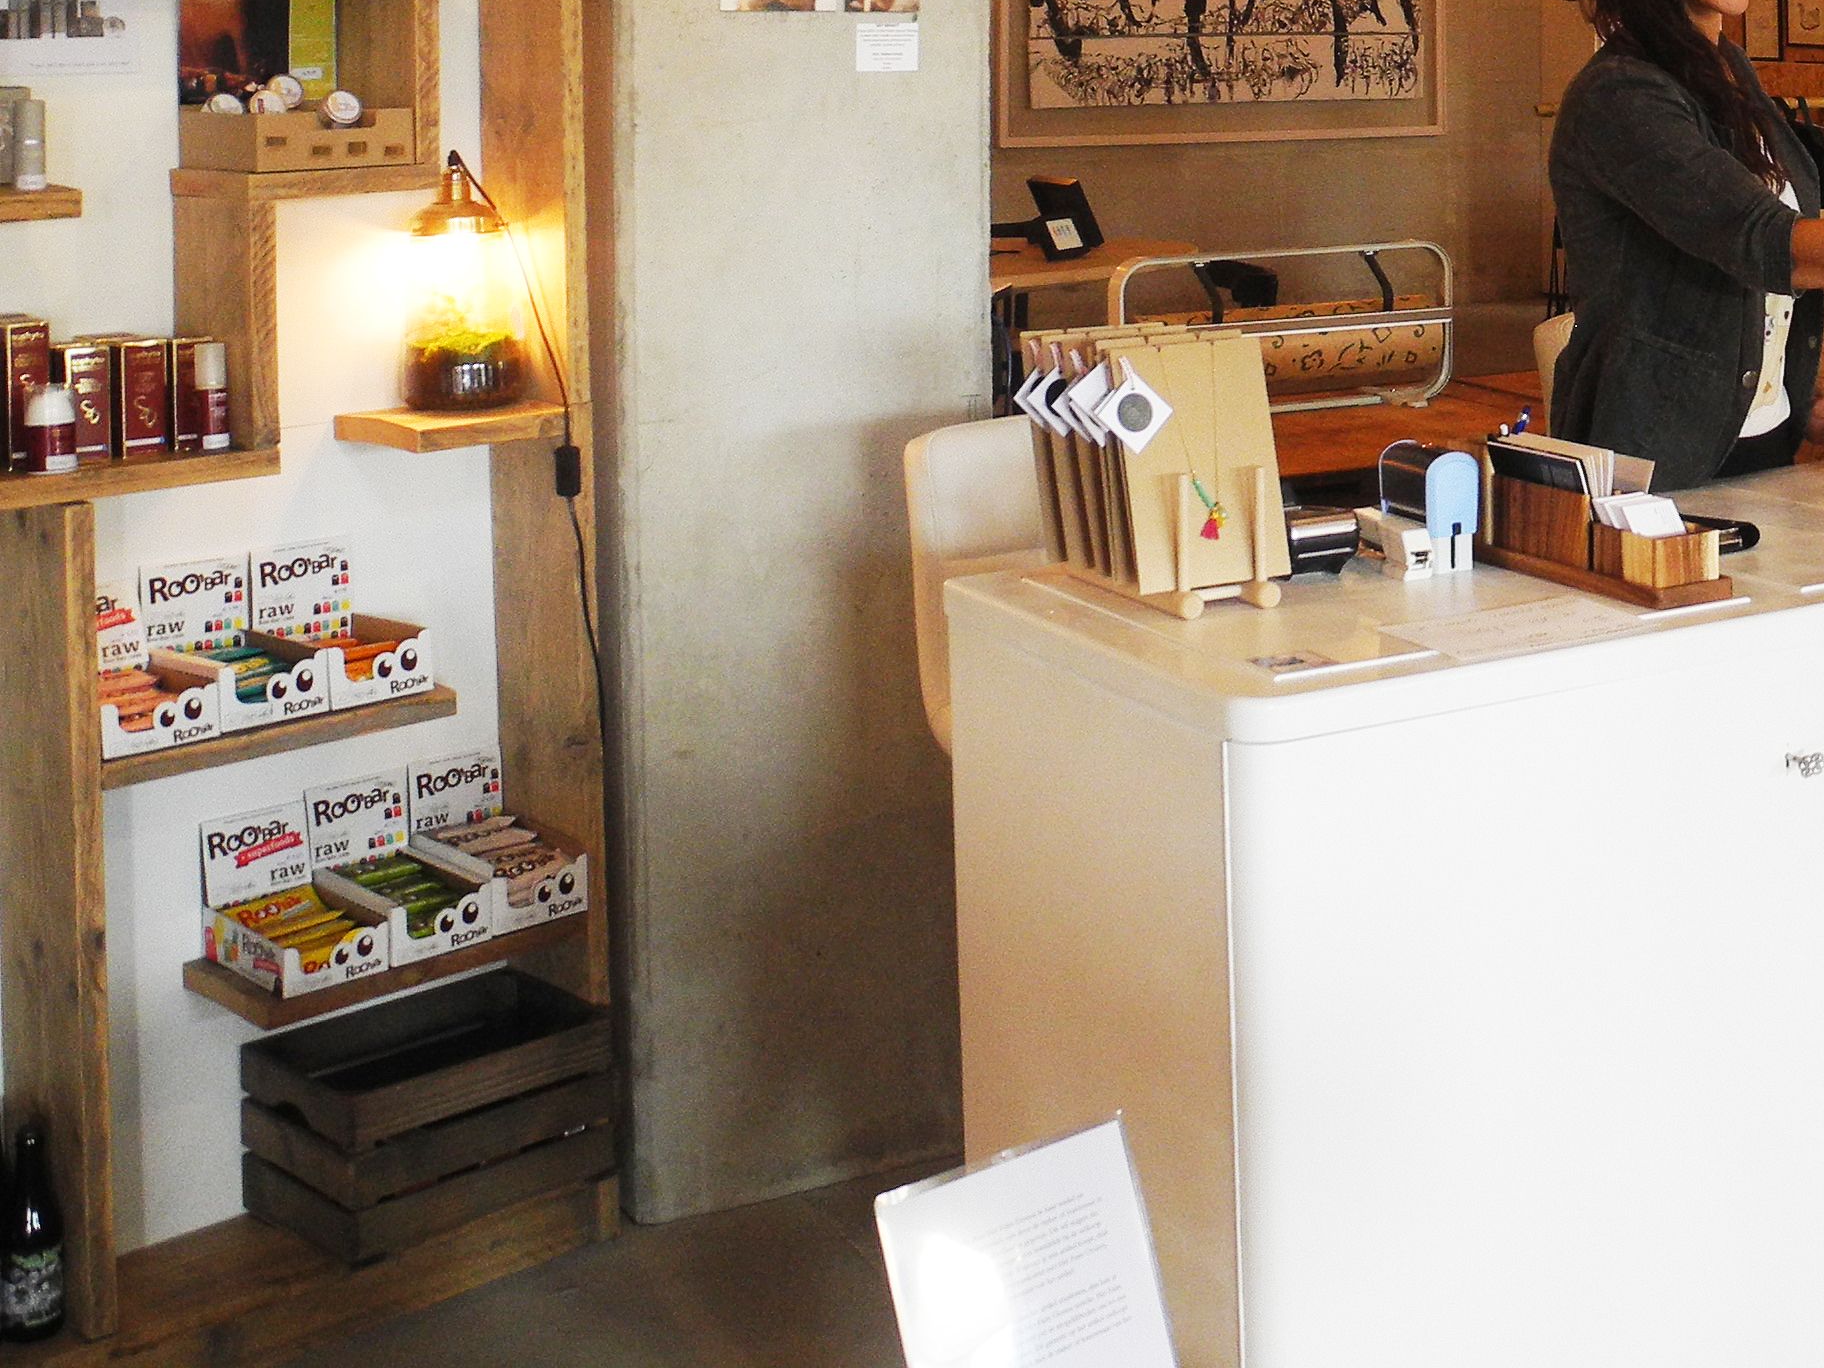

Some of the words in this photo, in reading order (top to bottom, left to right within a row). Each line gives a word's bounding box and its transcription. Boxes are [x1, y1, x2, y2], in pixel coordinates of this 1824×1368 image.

[259, 602, 295, 620] raw
[146, 618, 185, 637] raw
[101, 639, 140, 658] raw
[415, 812, 450, 830] raw
[314, 840, 350, 858] raw
[270, 862, 306, 882] raw
